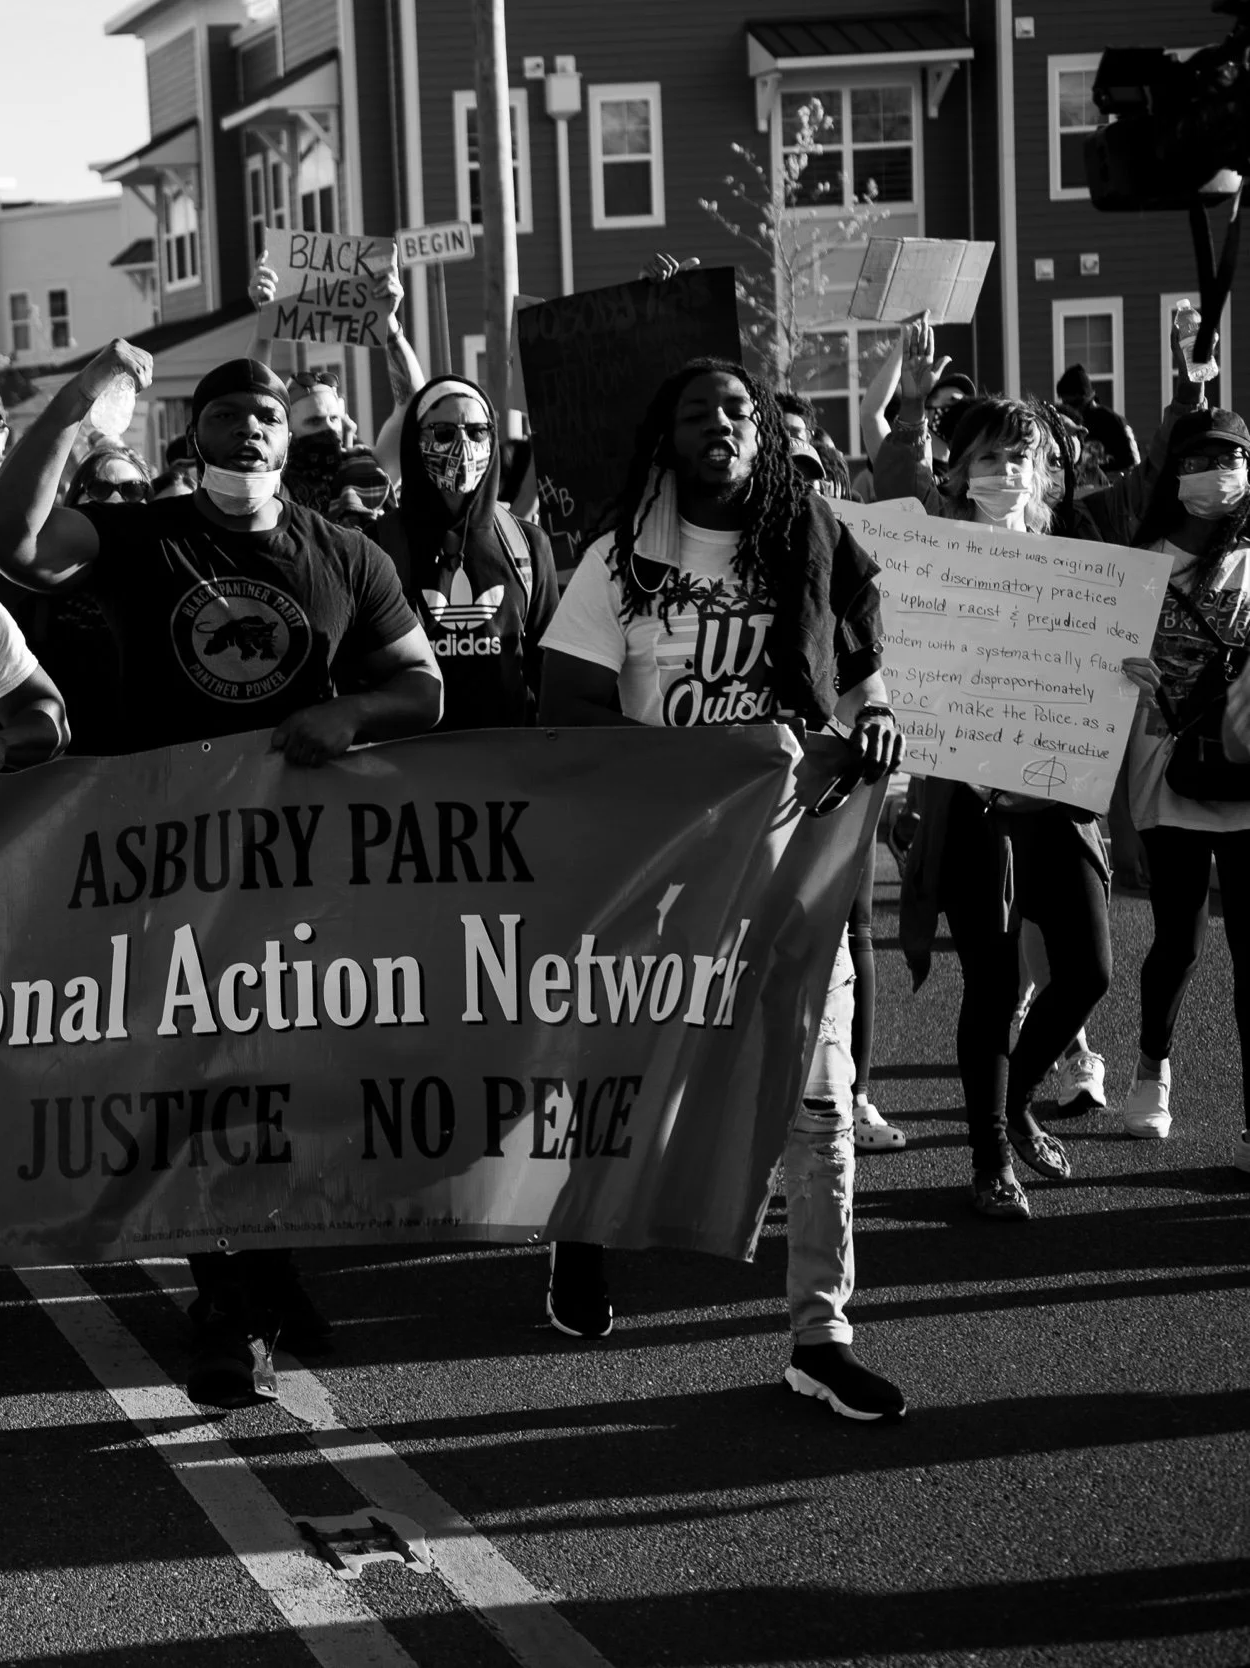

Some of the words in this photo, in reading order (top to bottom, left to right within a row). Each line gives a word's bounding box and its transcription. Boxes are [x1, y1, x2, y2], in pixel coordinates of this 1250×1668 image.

[289, 234, 376, 280] BLACK
[405, 230, 465, 258] BEGIN
[297, 274, 368, 309] LIVES
[274, 305, 381, 346] MATTER
[862, 519, 900, 541] Police
[903, 530, 940, 548] State
[947, 539, 960, 549] in
[966, 540, 983, 555] the
[1025, 552, 1048, 565] was
[1053, 558, 1126, 588] originally
[885, 558, 910, 573] out
[916, 563, 933, 578] of
[940, 567, 1043, 604] discriminatory
[1051, 585, 1118, 606] practices
[218, 582, 271, 602] PANTHER
[273, 596, 304, 628] PARTY
[900, 592, 947, 613] uphold
[958, 603, 1001, 617] racist
[1027, 612, 1097, 633] prejudiced
[878, 629, 922, 649] andem
[928, 639, 956, 652] with
[961, 644, 968, 653] a
[976, 645, 1082, 673] systematically
[188, 662, 239, 697] PANTHER
[246, 670, 287, 697] POWER
[970, 669, 1095, 703] disproportionately
[948, 700, 995, 719] make
[1002, 704, 1027, 721] the
[1082, 716, 1100, 729] as
[1105, 723, 1115, 734] a
[954, 723, 1003, 743] biased
[1033, 731, 1110, 760] destructive
[67, 804, 325, 910] ASBURY
[347, 800, 536, 885] PARK
[157, 923, 428, 1038] Action
[460, 914, 752, 1028] Network
[17, 1083, 292, 1183] JUSTICE
[360, 1075, 456, 1161] NO
[483, 1074, 643, 1160] PEACE
